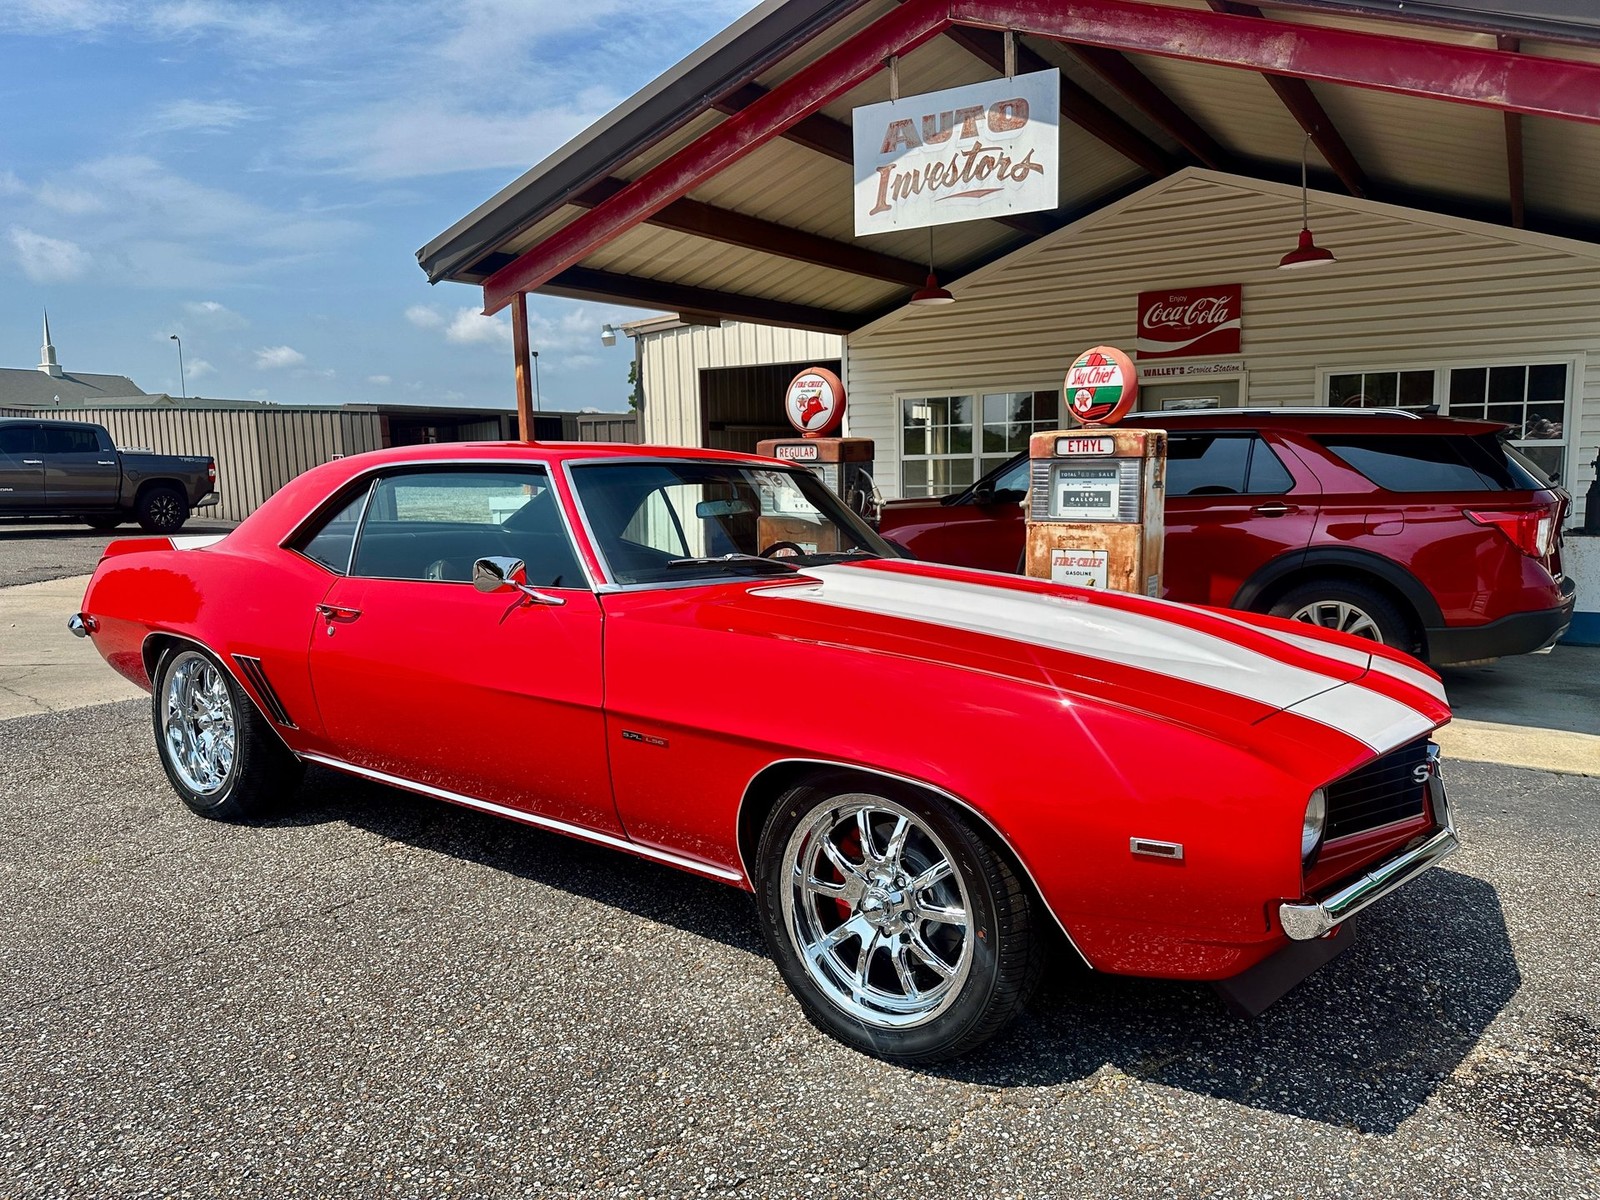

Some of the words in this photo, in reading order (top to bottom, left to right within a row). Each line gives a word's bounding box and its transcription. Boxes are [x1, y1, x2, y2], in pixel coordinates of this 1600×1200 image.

[880, 98, 1029, 154] AUTO
[869, 141, 1044, 216] Investors
[1169, 295, 1187, 303] Enjoy
[1143, 296, 1232, 329] Coca-Cola
[1072, 368, 1088, 386] Sky
[1087, 366, 1116, 384] Chief
[1143, 367, 1185, 377] WALLEY'S
[1187, 366, 1212, 374] Service
[1213, 364, 1240, 373] Station
[795, 380, 825, 388] FIRE-CHIEF
[779, 447, 815, 458] REGULAR
[1068, 439, 1104, 453] ETHYL
[1053, 556, 1105, 568] FIRE-CHIEF
